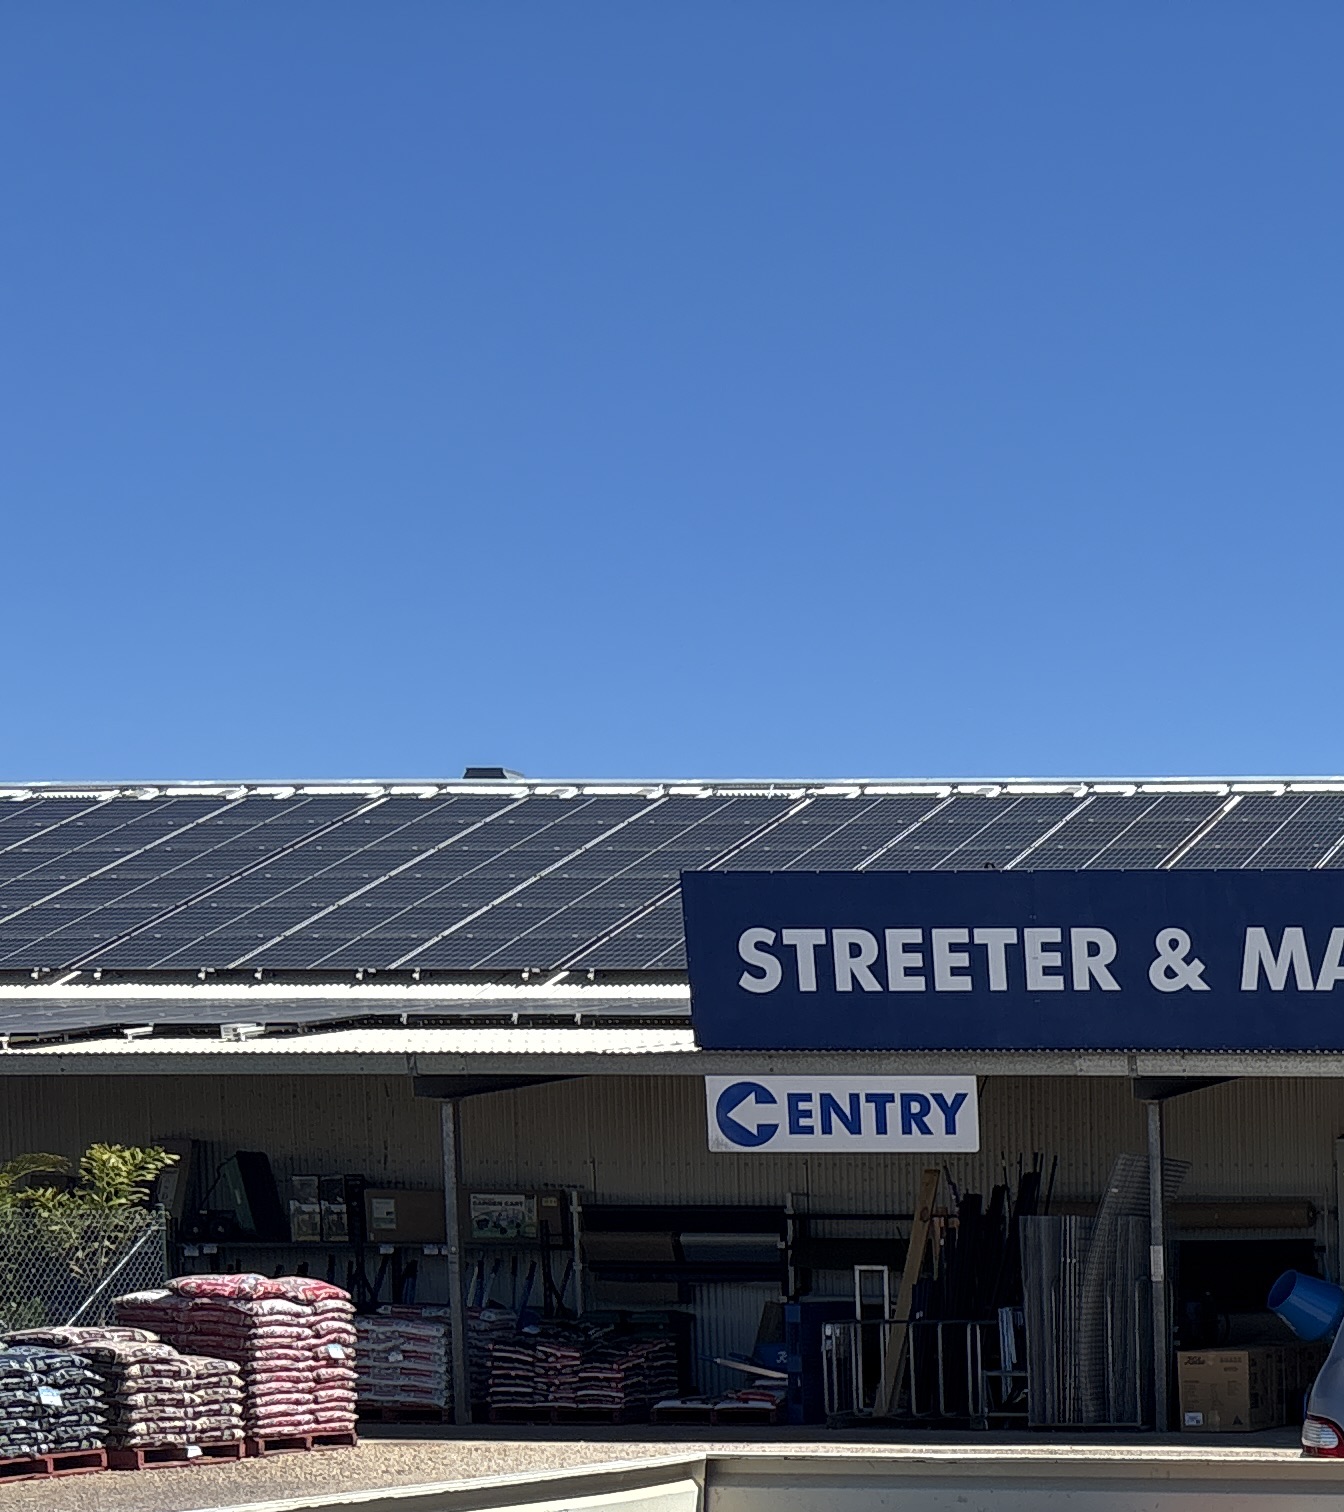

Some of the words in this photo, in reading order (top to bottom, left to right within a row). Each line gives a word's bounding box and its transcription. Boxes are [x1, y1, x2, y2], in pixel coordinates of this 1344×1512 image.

[738, 926, 1122, 994] STREETER
[1148, 926, 1212, 993] &
[787, 1092, 969, 1136] ENTRY
